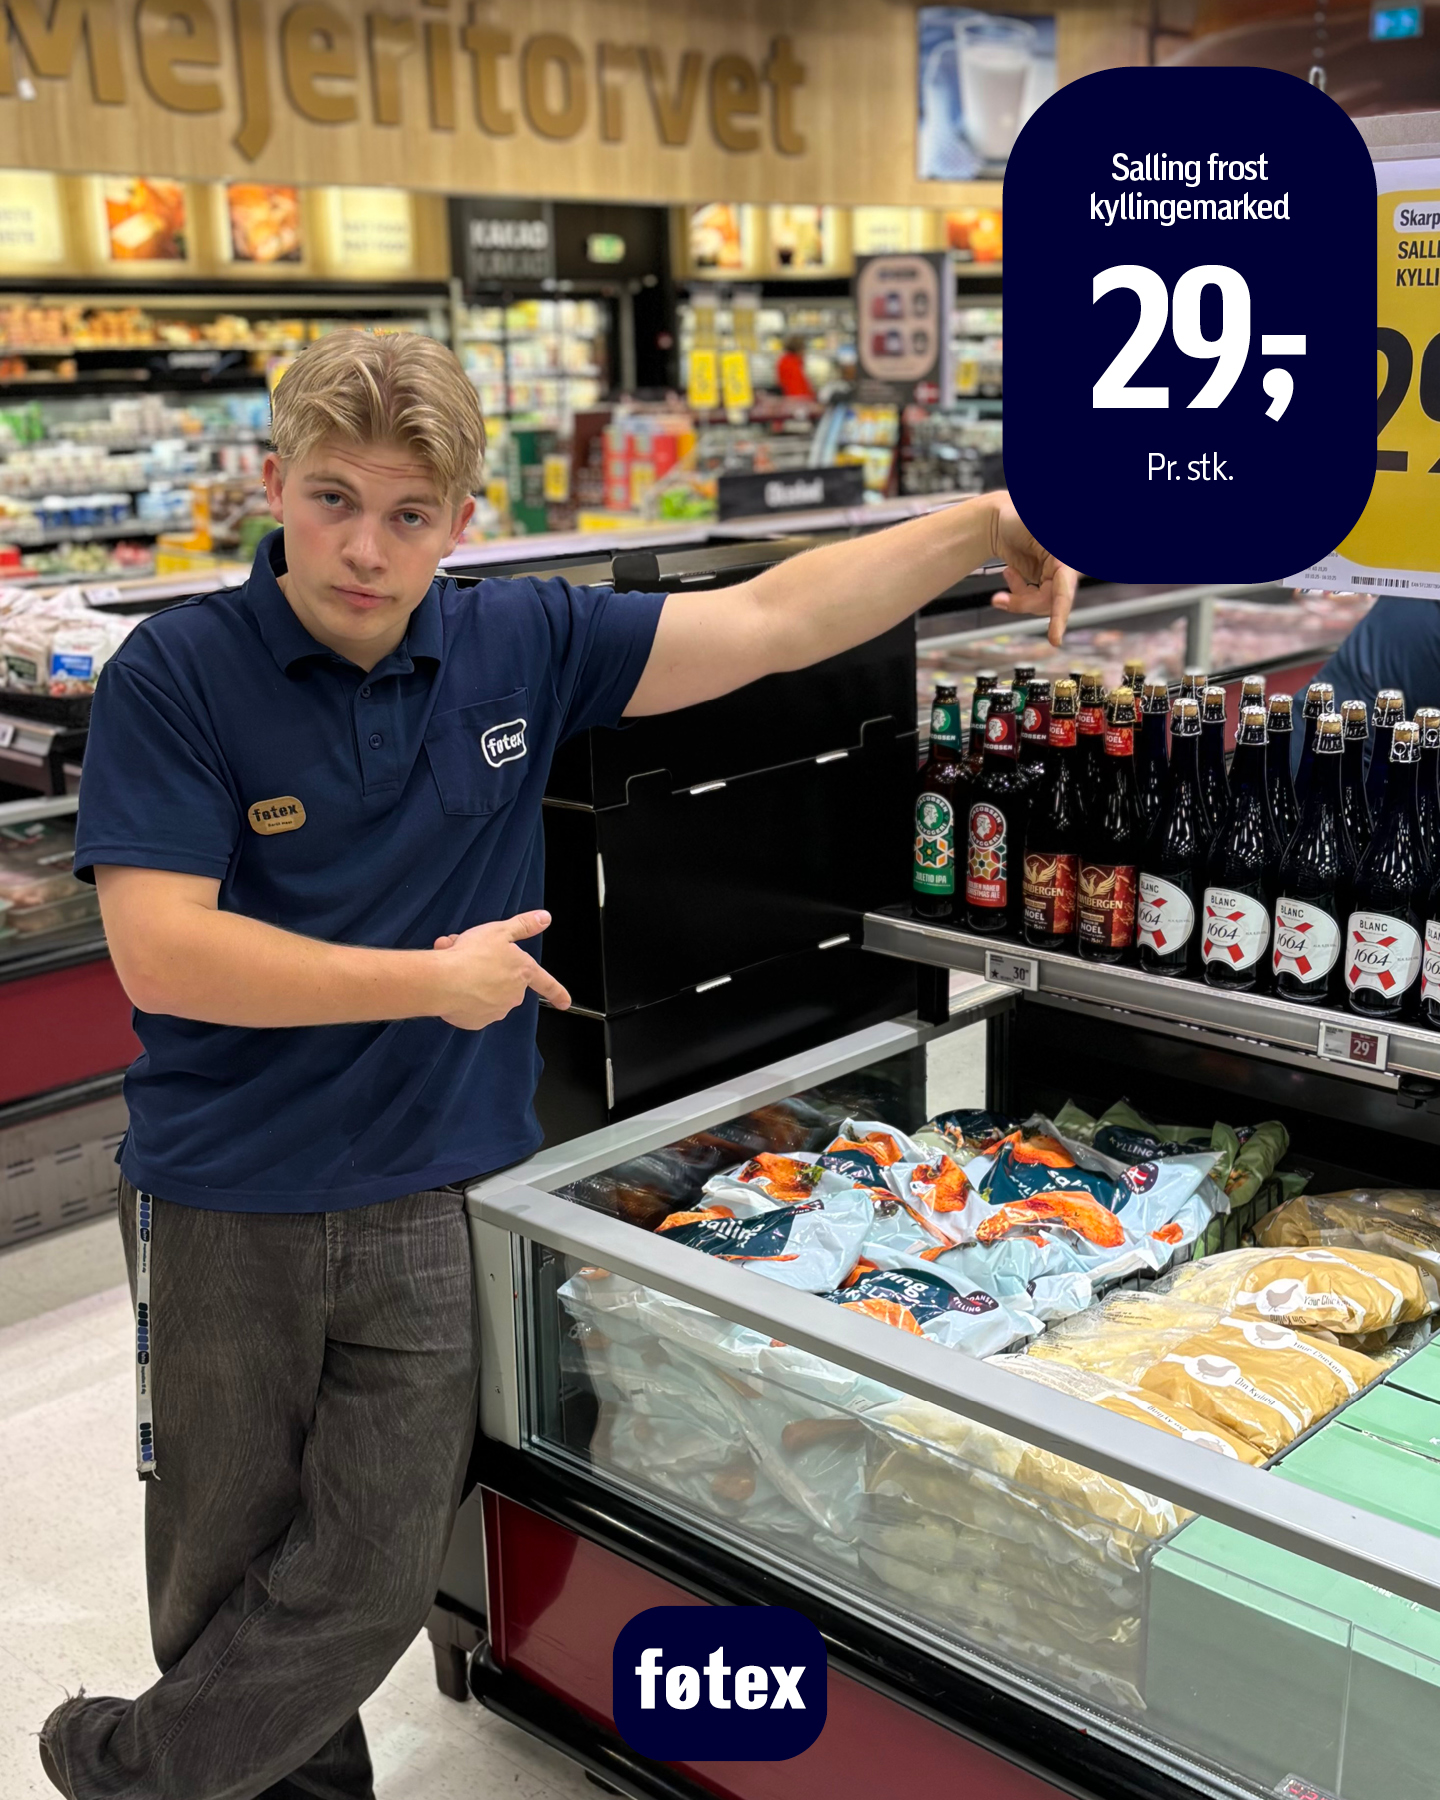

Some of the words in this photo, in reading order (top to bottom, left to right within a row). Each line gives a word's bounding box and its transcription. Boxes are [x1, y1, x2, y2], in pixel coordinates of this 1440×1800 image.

[0, 0, 807, 163] Mejeritorvet
[486, 731, 523, 758] føtex
[252, 804, 299, 822] føtex
[936, 875, 947, 884] IPA
[1210, 895, 1237, 908] BLANC
[1024, 909, 1045, 921] NOEL
[1280, 905, 1305, 918] BLANC
[1080, 922, 1103, 934] NOEL
[1206, 922, 1240, 940] 1664
[1359, 919, 1388, 932] BLANC
[1276, 932, 1308, 951] 1664
[1354, 948, 1392, 967] 1664
[1109, 1136, 1154, 1158] KYLLING
